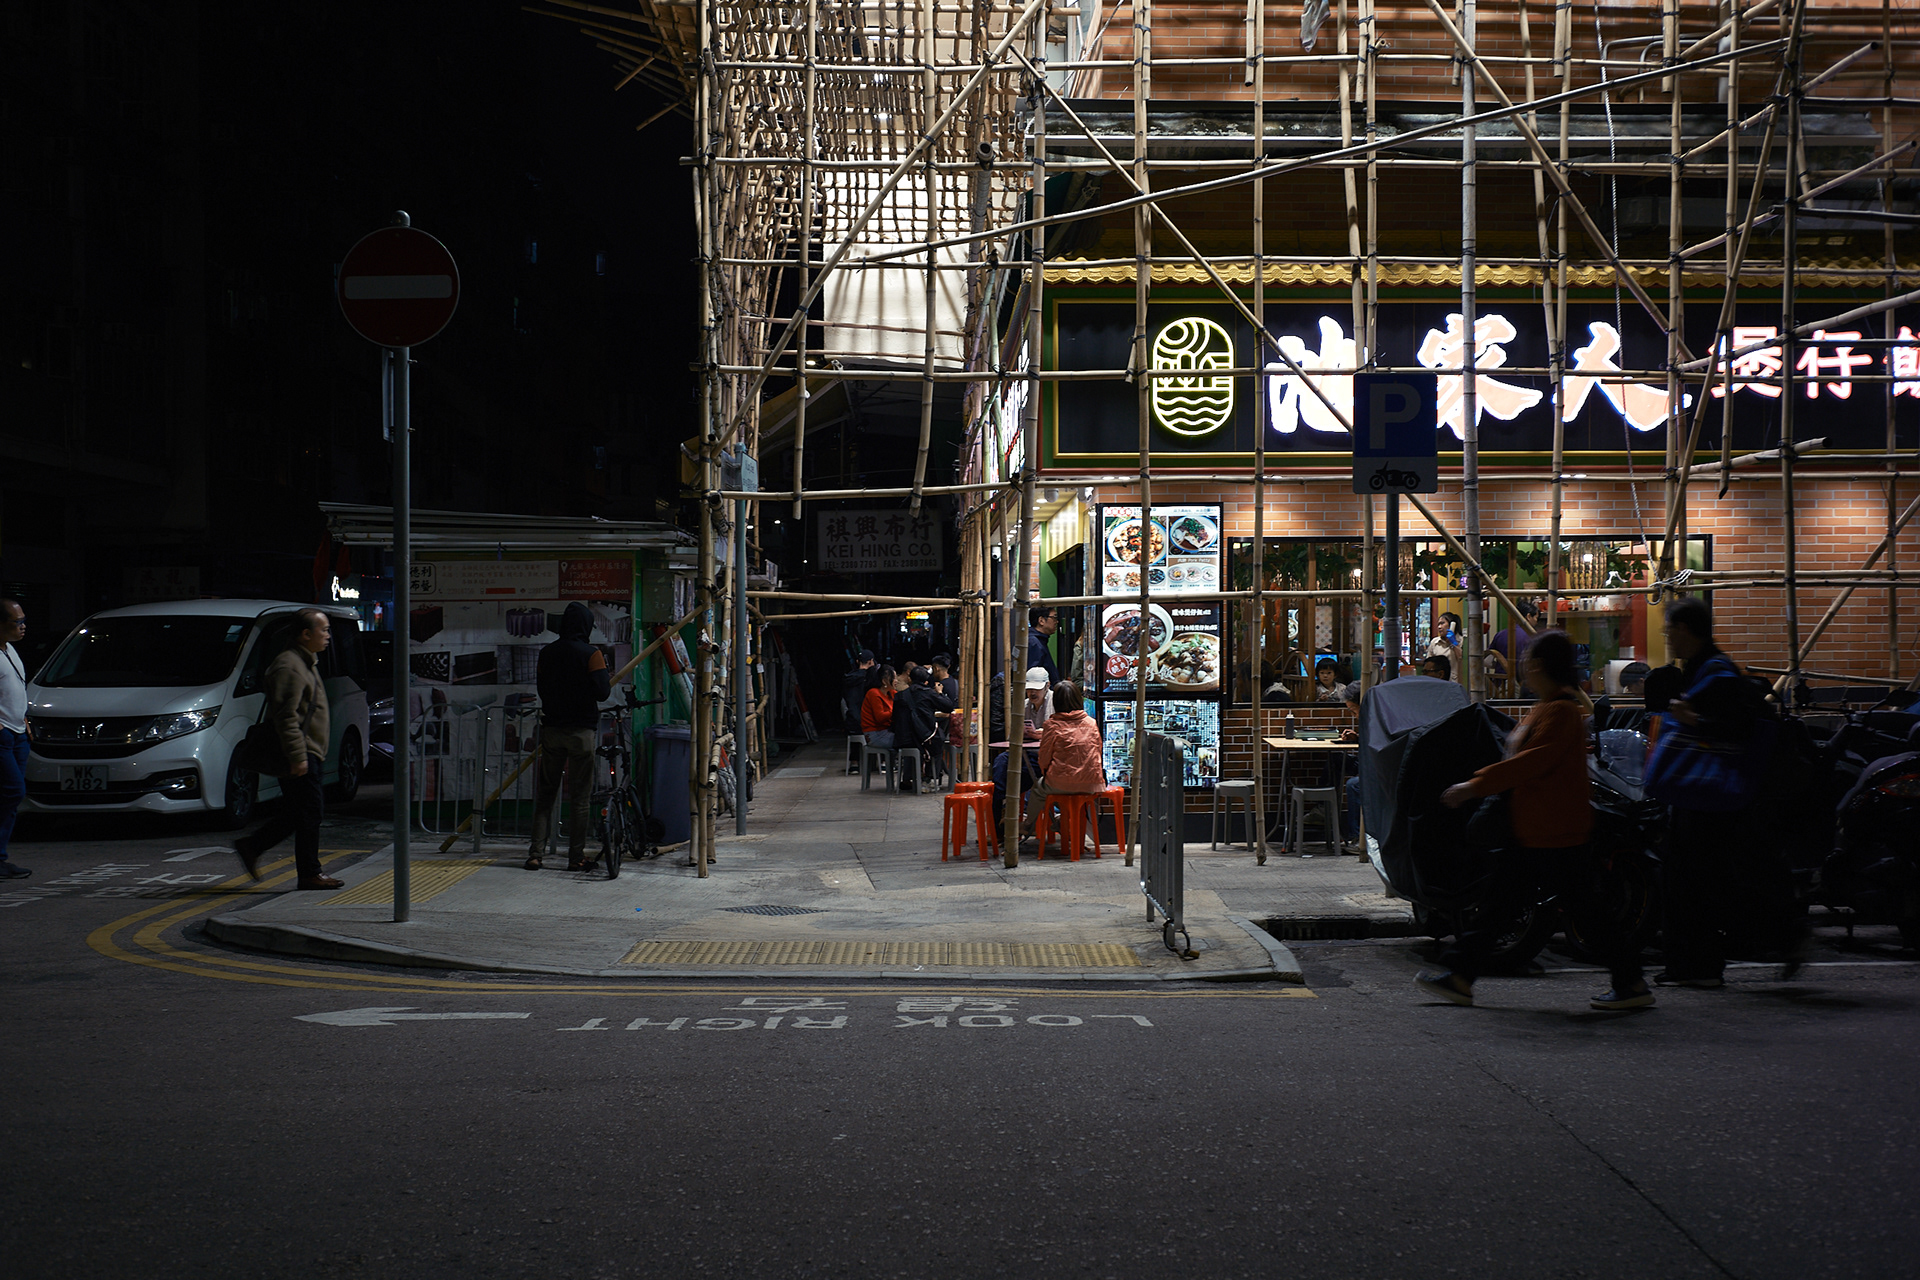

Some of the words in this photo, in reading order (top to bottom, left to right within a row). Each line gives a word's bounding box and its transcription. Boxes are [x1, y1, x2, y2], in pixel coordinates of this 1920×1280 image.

[1369, 383, 1421, 449] P
[827, 544, 853, 558] KEI
[861, 543, 902, 557] HING
[908, 542, 935, 557] CO.
[824, 561, 839, 569] TEL:
[883, 560, 899, 568] FAX:
[582, 580, 598, 588] Lung
[74, 766, 93, 778] WK
[65, 778, 102, 790] 2182
[555, 1015, 849, 1032] RIGHT
[892, 1014, 1155, 1028] LOOK
